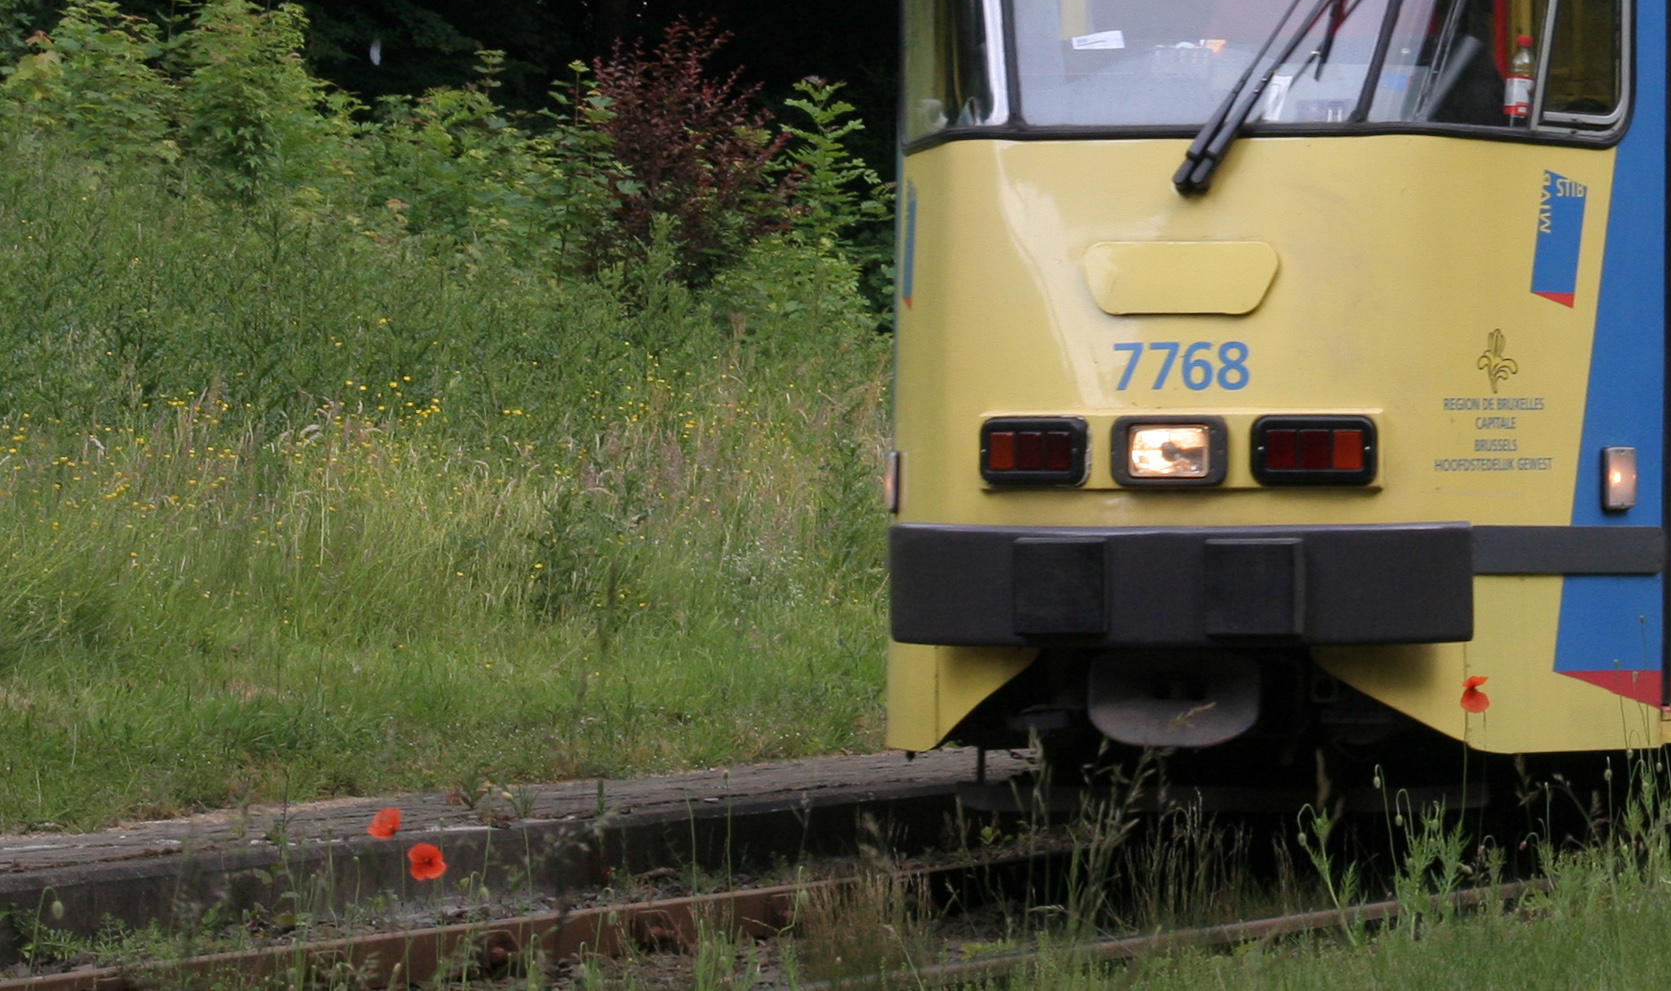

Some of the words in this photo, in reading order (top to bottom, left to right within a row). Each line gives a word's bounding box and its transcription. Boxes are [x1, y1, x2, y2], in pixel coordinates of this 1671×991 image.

[1556, 178, 1585, 198] STIB
[1113, 341, 1251, 391] 7768
[1443, 398, 1481, 411] REGION
[1482, 398, 1495, 410] DE
[1497, 398, 1545, 410] BRUXELLES
[1475, 417, 1517, 430] CAPITALE
[1474, 439, 1518, 452] BRUSSELS
[1518, 458, 1553, 471] GEWEST
